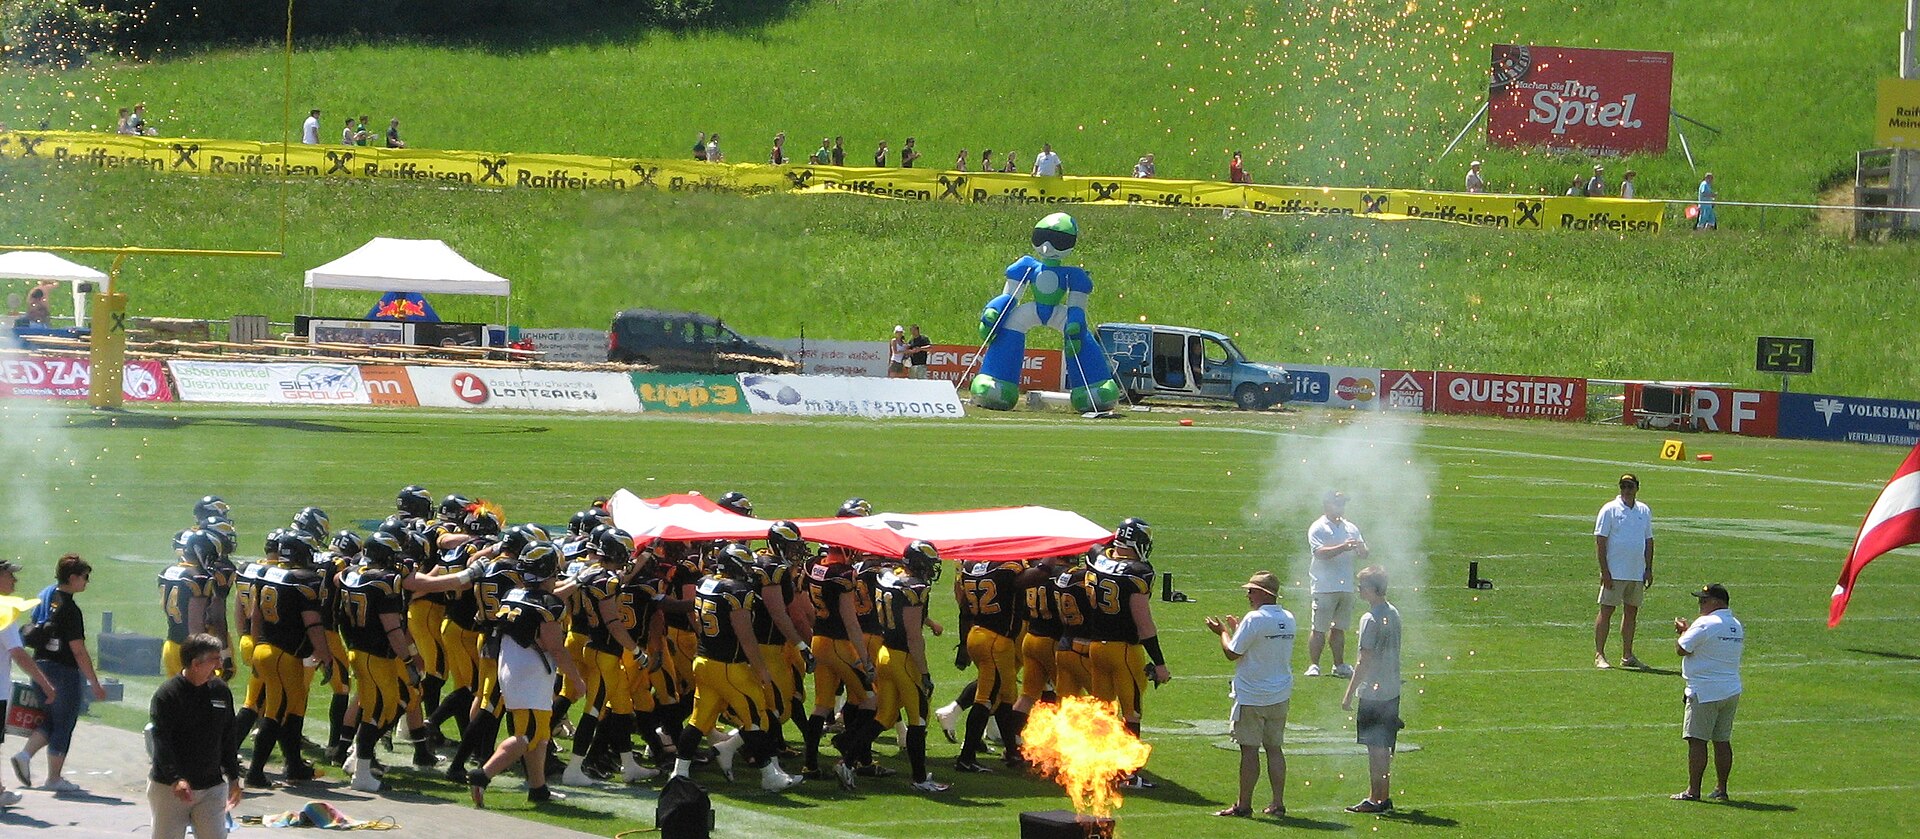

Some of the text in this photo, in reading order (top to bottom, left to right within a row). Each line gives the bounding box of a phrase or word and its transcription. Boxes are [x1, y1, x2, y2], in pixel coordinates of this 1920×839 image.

[1528, 91, 1642, 134] Spiel.
[210, 155, 319, 175] Raiffeisen
[364, 162, 473, 183] Raiffeisen
[517, 168, 626, 190] Raiffeisen
[823, 180, 931, 200] Raiffeisen
[1561, 212, 1659, 233] Raiffeisen
[1767, 343, 1802, 367] 25
[0, 360, 91, 385] ED ZA
[175, 364, 271, 378] Lebensmittel
[181, 378, 271, 392] Distributeur
[283, 390, 355, 400] GROUP
[1448, 377, 1575, 407] QUESTER!
[1389, 390, 1423, 407] Profi
[1665, 444, 1676, 457] G
[964, 579, 1002, 616] 52
